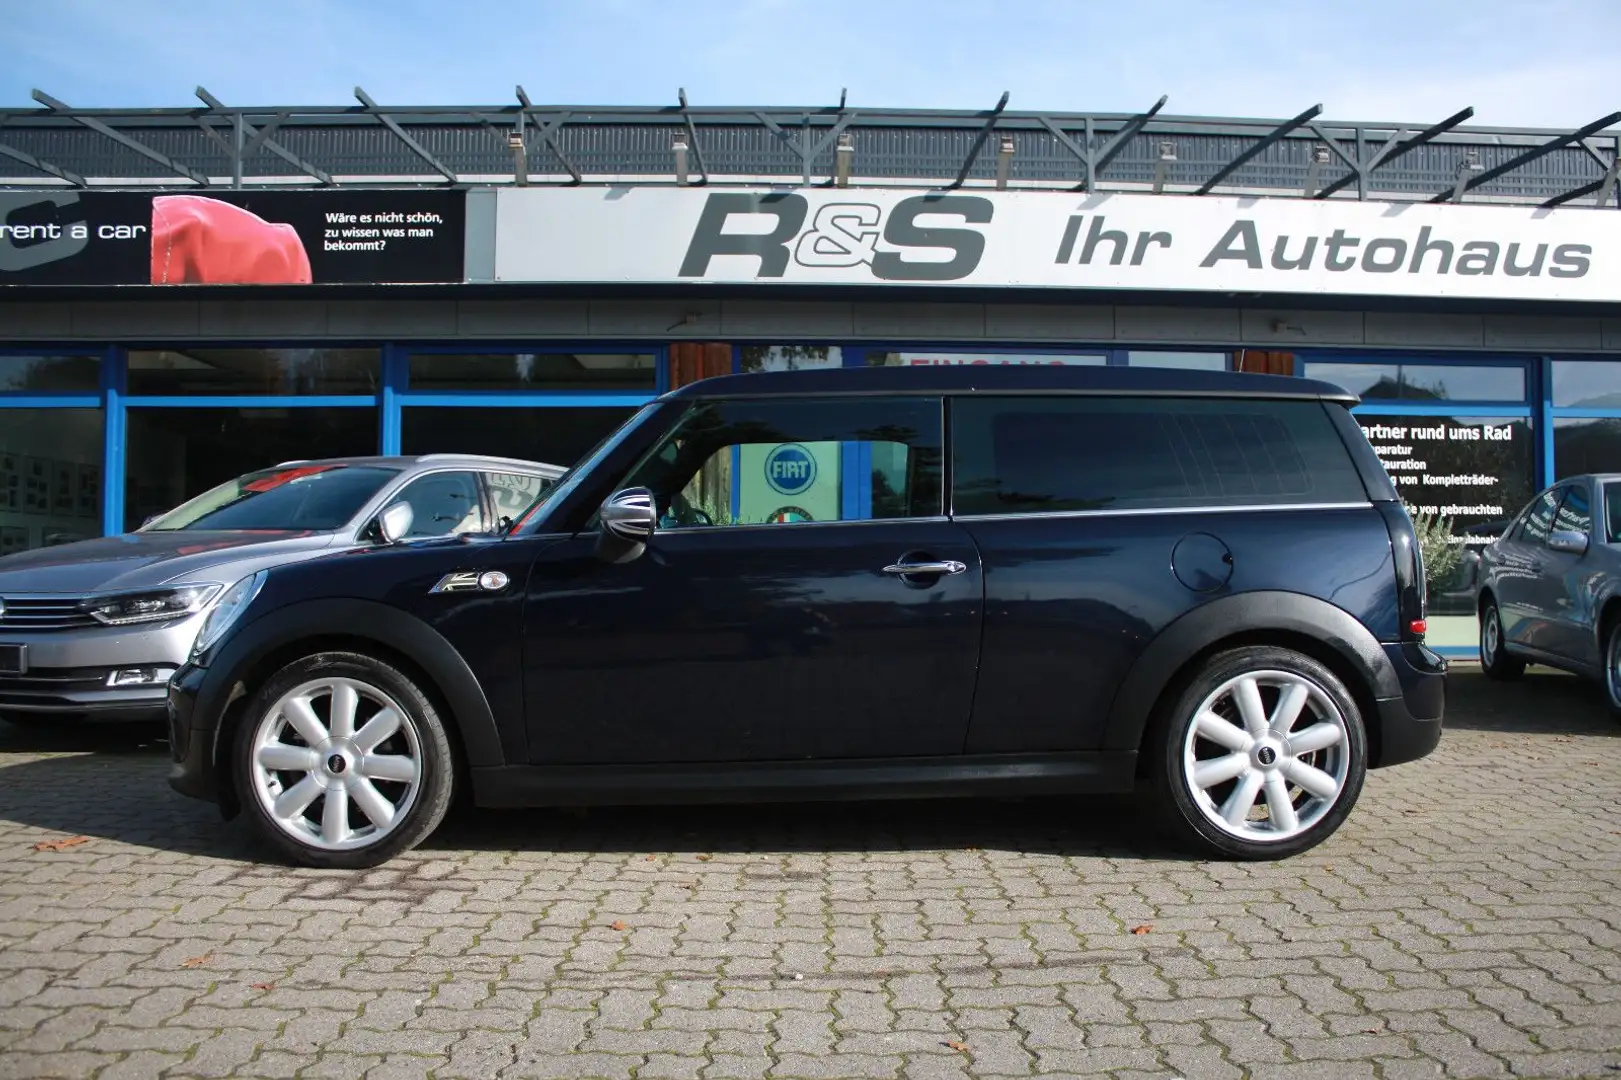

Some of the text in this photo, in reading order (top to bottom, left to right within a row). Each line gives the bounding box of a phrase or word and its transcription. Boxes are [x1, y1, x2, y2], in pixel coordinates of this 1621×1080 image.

[325, 212, 443, 224] Wäre es nicht schön,
[0, 223, 147, 239] rent a car
[324, 227, 434, 237] zu wissen was man
[678, 193, 1592, 281] R&S Ihr Autohaus
[324, 240, 386, 251] bekommt?
[1360, 424, 1512, 440] artner rund ums Rad
[1373, 445, 1413, 456] paratur
[773, 460, 809, 479] FIAT
[1400, 475, 1418, 485] von
[1423, 474, 1499, 487] Kompletträder-
[1420, 506, 1438, 514] von
[1441, 504, 1503, 516] gebrauchten
